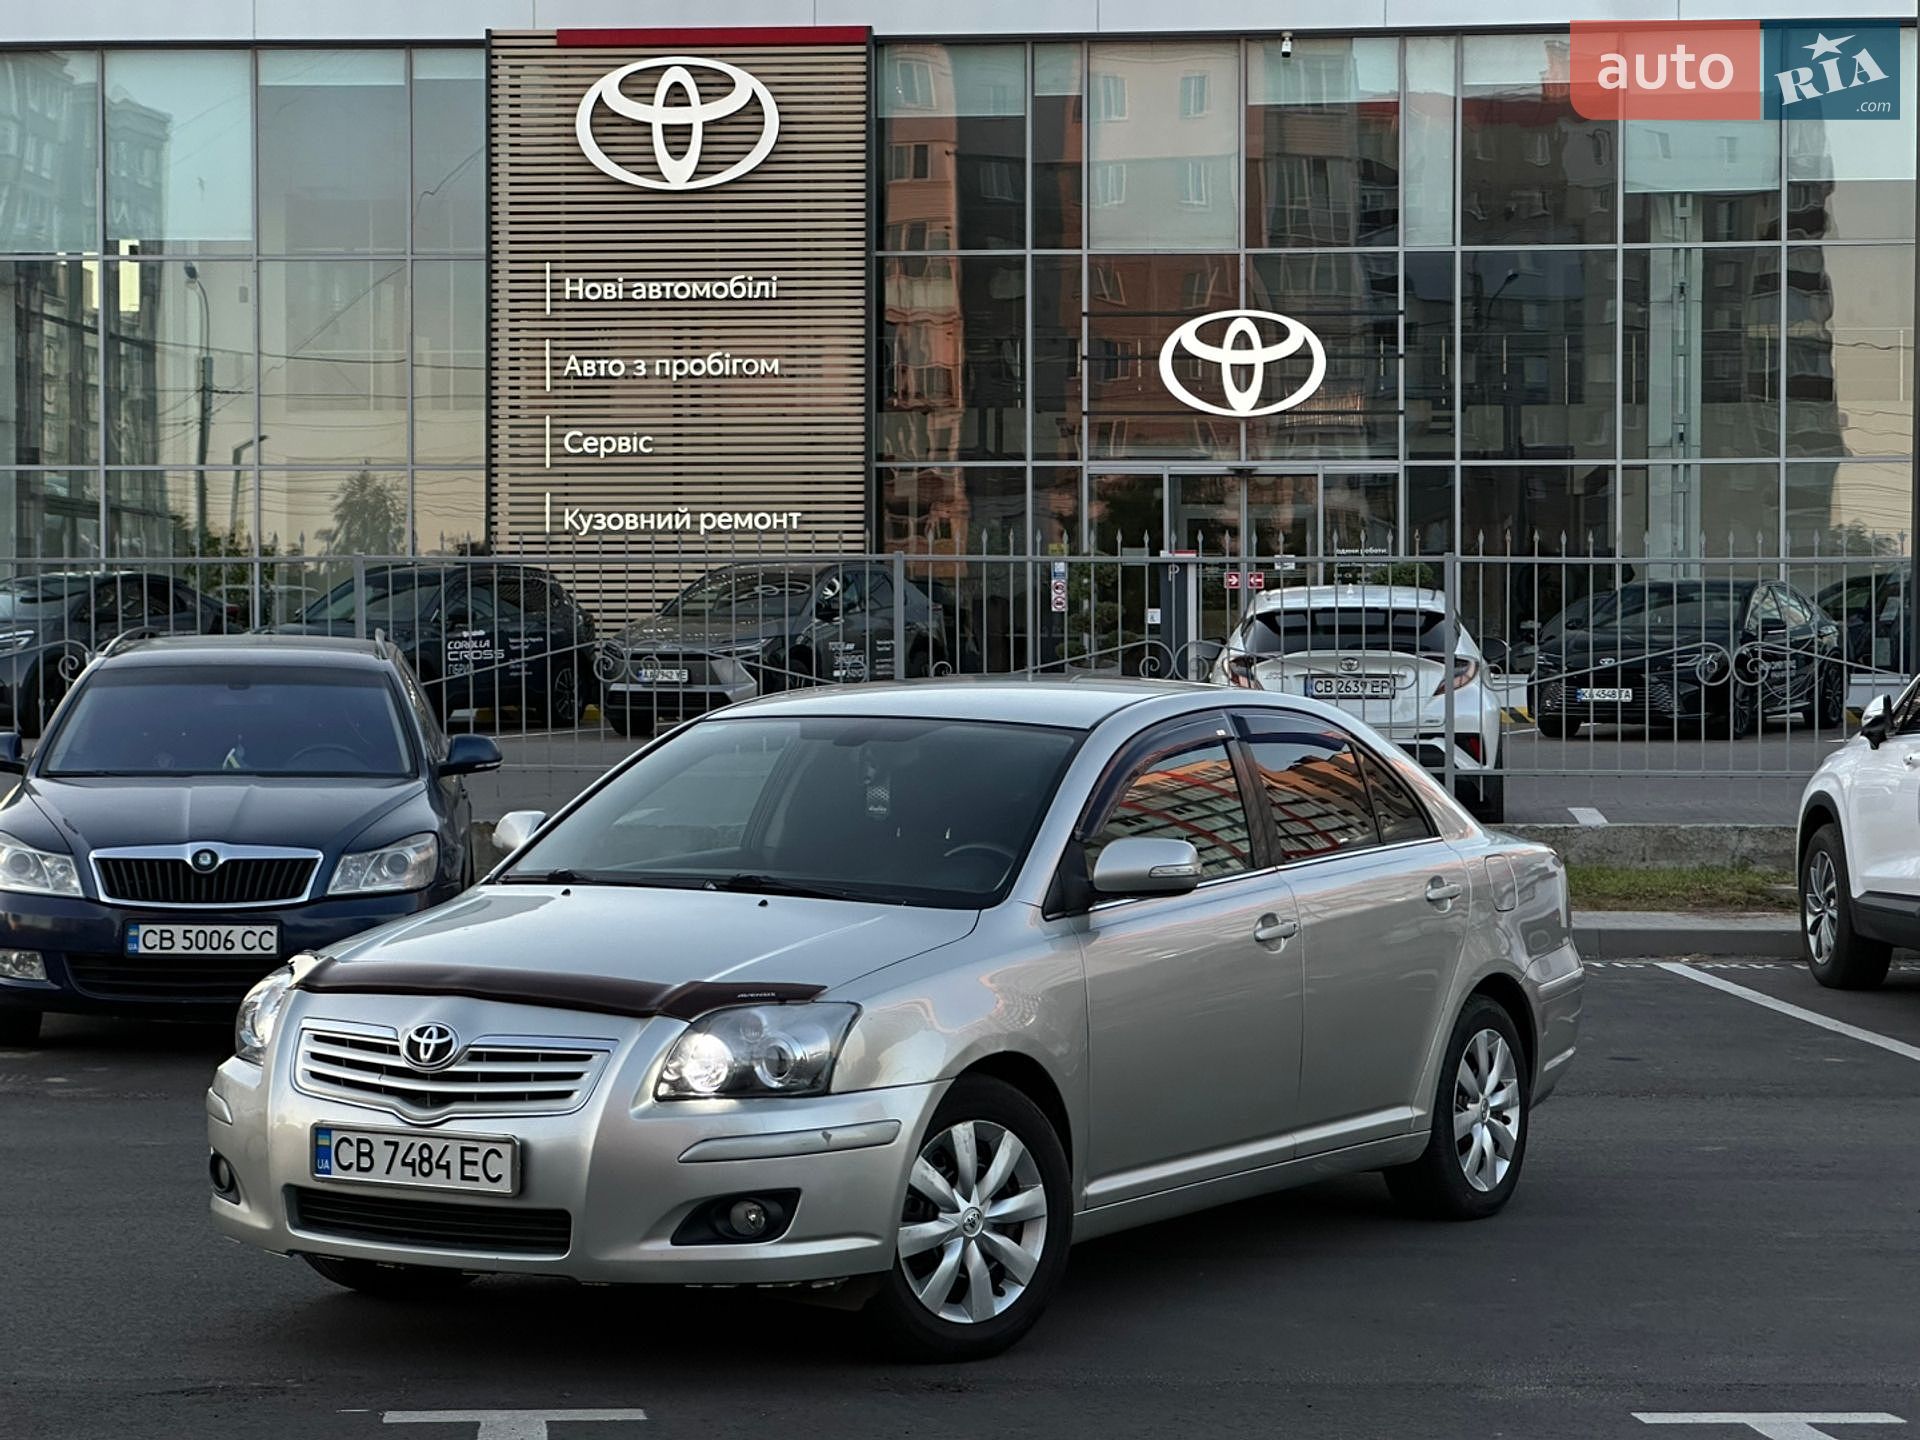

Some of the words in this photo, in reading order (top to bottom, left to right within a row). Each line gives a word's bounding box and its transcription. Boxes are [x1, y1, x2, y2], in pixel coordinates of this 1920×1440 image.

[565, 277, 624, 300] Нові
[631, 275, 778, 299] автомобілі
[563, 354, 625, 377] Авто
[633, 358, 647, 376] з
[655, 352, 779, 381] пробігом
[563, 430, 654, 459] Сервіс
[564, 507, 691, 536] Кузовний
[700, 512, 802, 535] ремонт
[447, 640, 491, 650] COROLLA
[447, 650, 505, 661] CROSS
[1314, 680, 1334, 693] CB
[1337, 680, 1367, 693] 2639
[142, 929, 175, 951] CB
[181, 929, 236, 951] 5006
[241, 930, 274, 951] CC
[317, 1158, 330, 1171] UA
[334, 1136, 375, 1173] CB
[384, 1140, 451, 1180] 7484
[460, 1145, 503, 1184] EC
